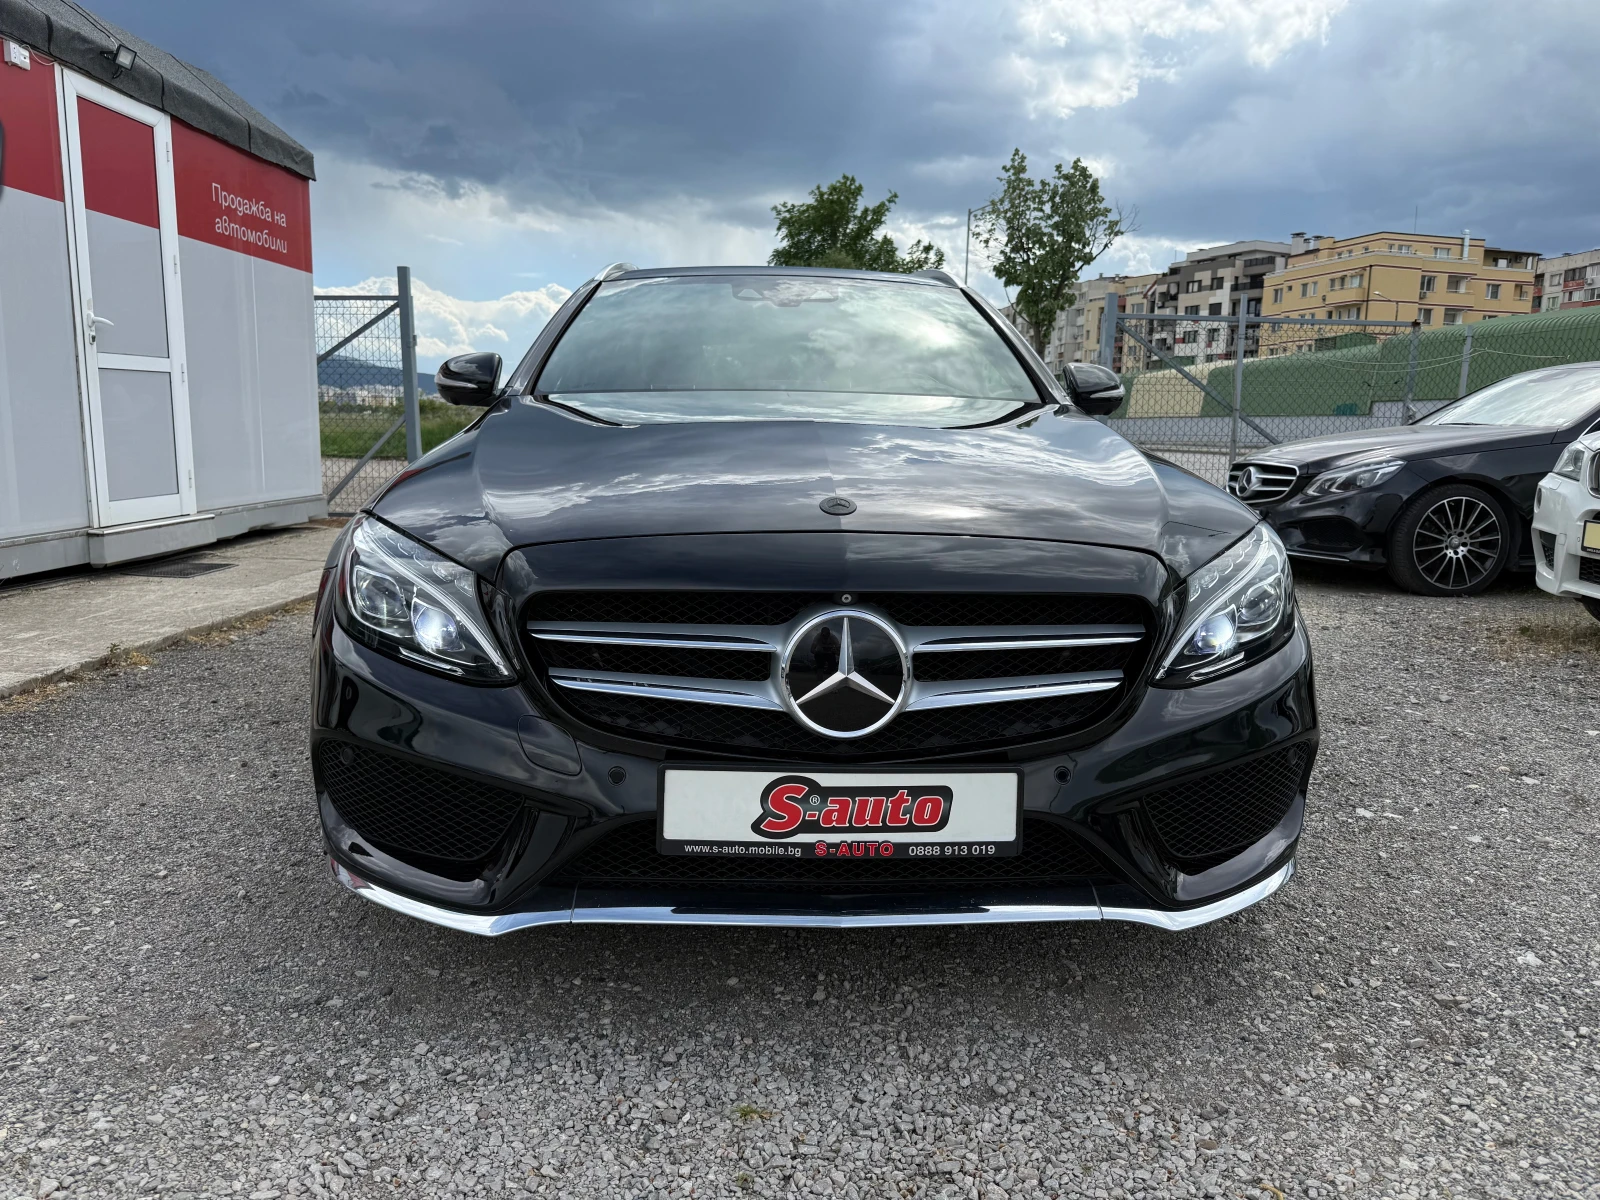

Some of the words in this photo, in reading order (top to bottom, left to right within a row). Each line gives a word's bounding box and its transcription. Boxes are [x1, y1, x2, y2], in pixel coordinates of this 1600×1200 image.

[211, 182, 272, 222] Продажба
[274, 210, 287, 227] на
[215, 215, 287, 253] автомобили
[684, 844, 802, 857] www.s-auto.mobile.bg
[814, 842, 894, 857] S-AUTO
[908, 846, 941, 856] 0888
[944, 845, 968, 855] 913
[971, 845, 996, 855] 019
